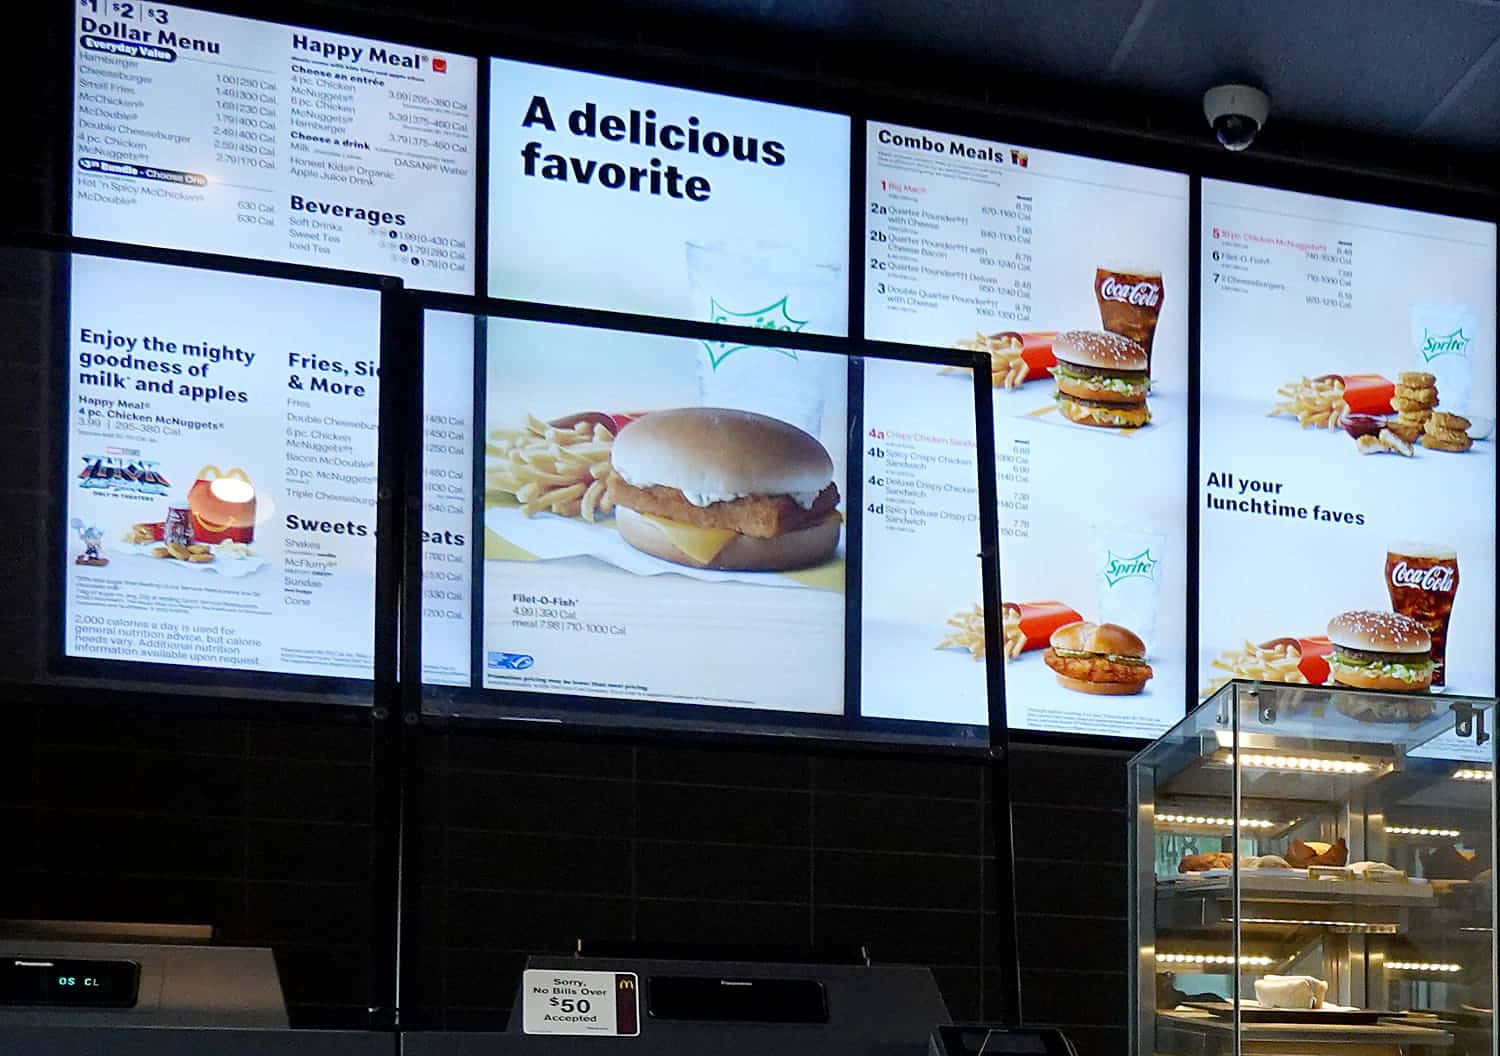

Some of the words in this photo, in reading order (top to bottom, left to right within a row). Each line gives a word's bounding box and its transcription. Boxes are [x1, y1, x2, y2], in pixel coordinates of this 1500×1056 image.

[81, 17, 152, 42] Dollar
[158, 30, 220, 54] Menu
[85, 37, 138, 56] Everyday
[140, 46, 171, 60] Value
[293, 34, 362, 62] Happy
[79, 52, 139, 68] Hamburger
[79, 66, 152, 85] Cheeseburger
[291, 65, 331, 79] Choose
[334, 71, 348, 80] an
[355, 74, 385, 87] entrée
[79, 119, 115, 132] Double
[119, 125, 192, 144] Cheeseburger
[290, 118, 346, 134] Hamburger
[521, 95, 556, 132] A
[568, 102, 786, 167] delicious
[290, 131, 331, 145] Choose
[343, 138, 370, 151] drink
[878, 129, 945, 153] Combo
[950, 142, 1004, 164] Meals
[290, 156, 325, 169] Honest
[290, 167, 317, 180] Apple
[321, 171, 347, 182] Juice
[350, 175, 374, 185] Drink
[520, 141, 712, 203] favorite
[881, 180, 887, 191] 1
[290, 194, 406, 226] Beverages
[871, 202, 887, 215] 2a
[290, 217, 309, 228] Soft
[312, 220, 343, 232] Drinks
[289, 229, 320, 241] Sweet
[870, 230, 887, 244] 2b
[1212, 228, 1220, 239] 5
[1212, 250, 1220, 262] 6
[870, 258, 887, 271] 2c
[1213, 273, 1220, 284] 7
[877, 282, 886, 295] 3
[1101, 275, 1160, 307] Coca-Cola
[80, 328, 137, 352] Enjoy
[143, 336, 177, 354] the
[182, 342, 257, 367] mighty
[1423, 337, 1465, 352] Sprite
[79, 351, 182, 376] goodness
[188, 363, 210, 378] of
[287, 351, 349, 375] Fries,
[135, 378, 174, 394] and
[179, 385, 249, 404] apples
[287, 374, 304, 391] &
[310, 377, 366, 397] More
[79, 395, 116, 409] Happy
[287, 397, 311, 409] Fries
[79, 407, 85, 416] 4
[107, 410, 153, 423] Chicken
[287, 412, 321, 426] Double
[868, 427, 885, 440] 4a
[286, 452, 319, 465] Bacon
[867, 447, 885, 459] 4b
[868, 475, 884, 488] 4c
[1206, 472, 1233, 489] All
[1238, 478, 1283, 495] your
[287, 489, 317, 500] Triple
[867, 503, 884, 515] 4d
[1206, 493, 1308, 519] lunchtime
[1313, 504, 1366, 526] faves
[286, 514, 368, 537] Sweets
[285, 538, 321, 550] Shakes
[1105, 557, 1151, 578] Sprite
[284, 576, 323, 589] Sundae
[1392, 561, 1454, 593] Coca-Cola
[284, 595, 311, 607] Cone
[75, 614, 105, 627] 2,000
[107, 616, 149, 630] calories
[160, 620, 178, 634] day
[182, 623, 190, 632] is
[192, 624, 220, 634] used
[222, 626, 236, 636] for
[75, 625, 116, 638] general
[118, 627, 165, 640] nutrition
[206, 634, 223, 644] but
[226, 636, 262, 648] calorie
[75, 634, 108, 645] needs
[138, 638, 192, 651] Additional
[195, 643, 241, 655] nutrition
[75, 643, 137, 655] information
[141, 647, 188, 659] available
[190, 652, 216, 664] upon
[581, 988, 607, 996] Over
[549, 997, 591, 1014] $50
[544, 1014, 597, 1022] Accepted
